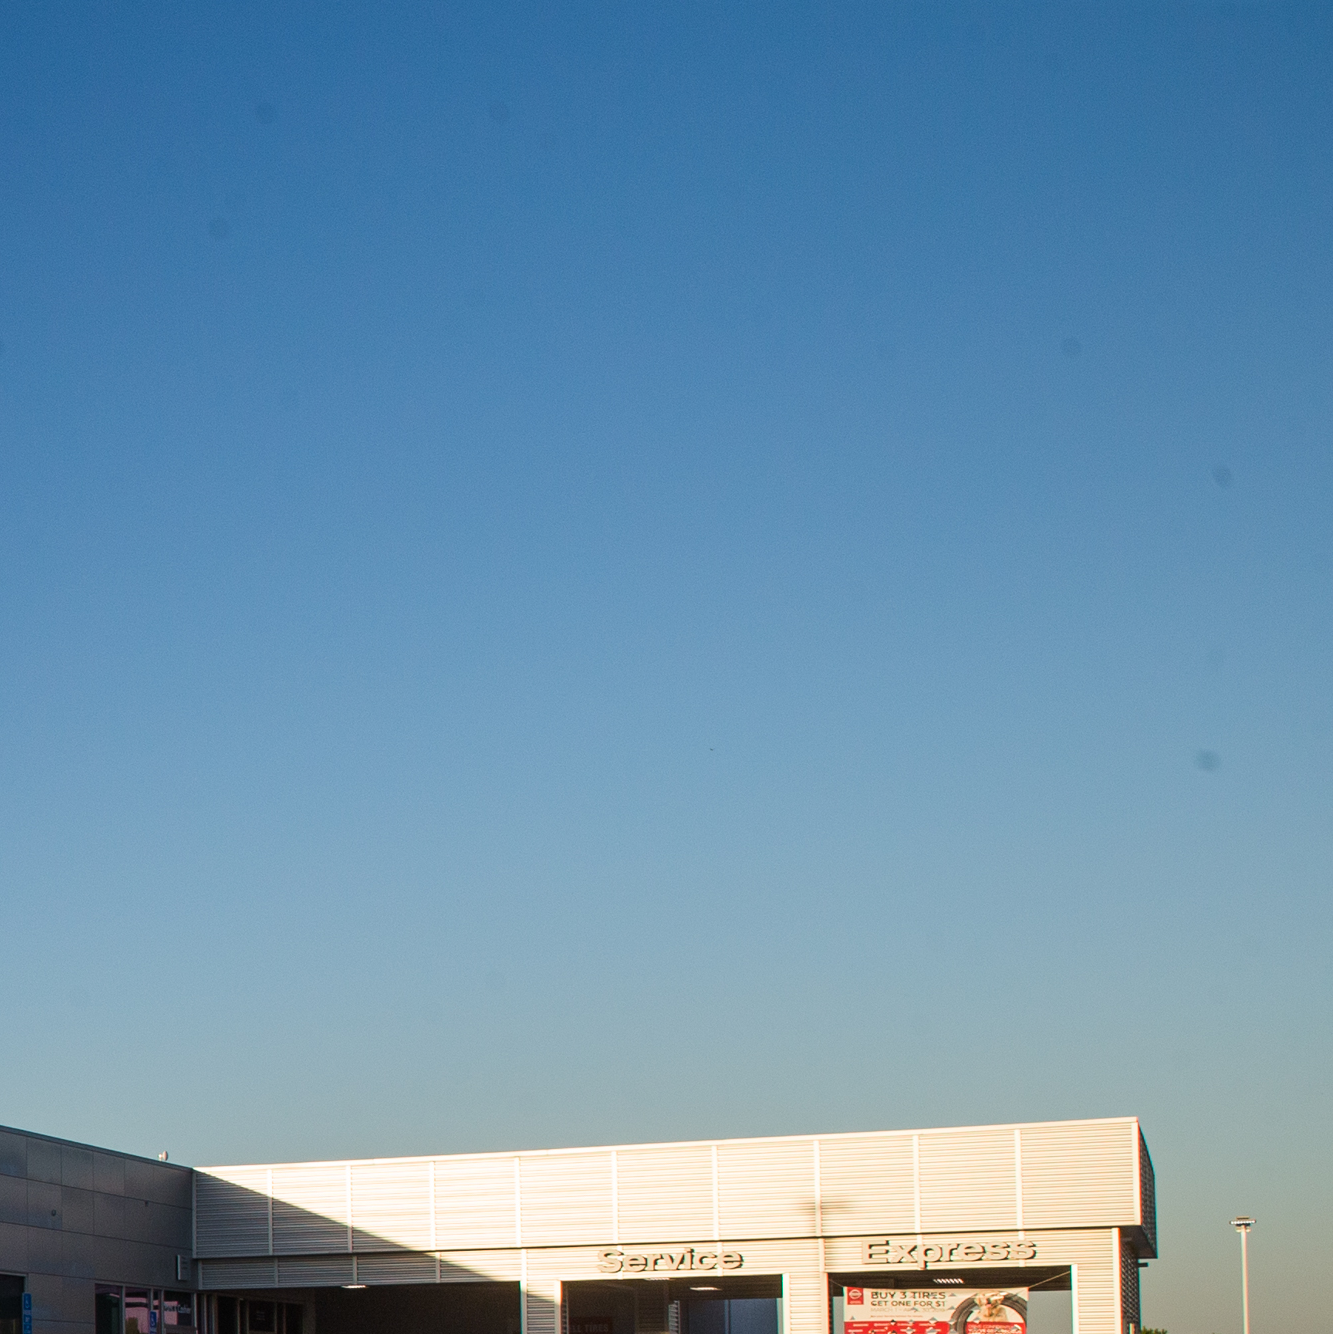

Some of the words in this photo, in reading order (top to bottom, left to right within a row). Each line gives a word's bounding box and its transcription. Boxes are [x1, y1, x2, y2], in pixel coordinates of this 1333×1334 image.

[597, 1247, 745, 1273] Service
[862, 1239, 1037, 1270] Express
[871, 1291, 896, 1300] BUY
[900, 1291, 907, 1300] 3
[910, 1291, 946, 1300] TIRES
